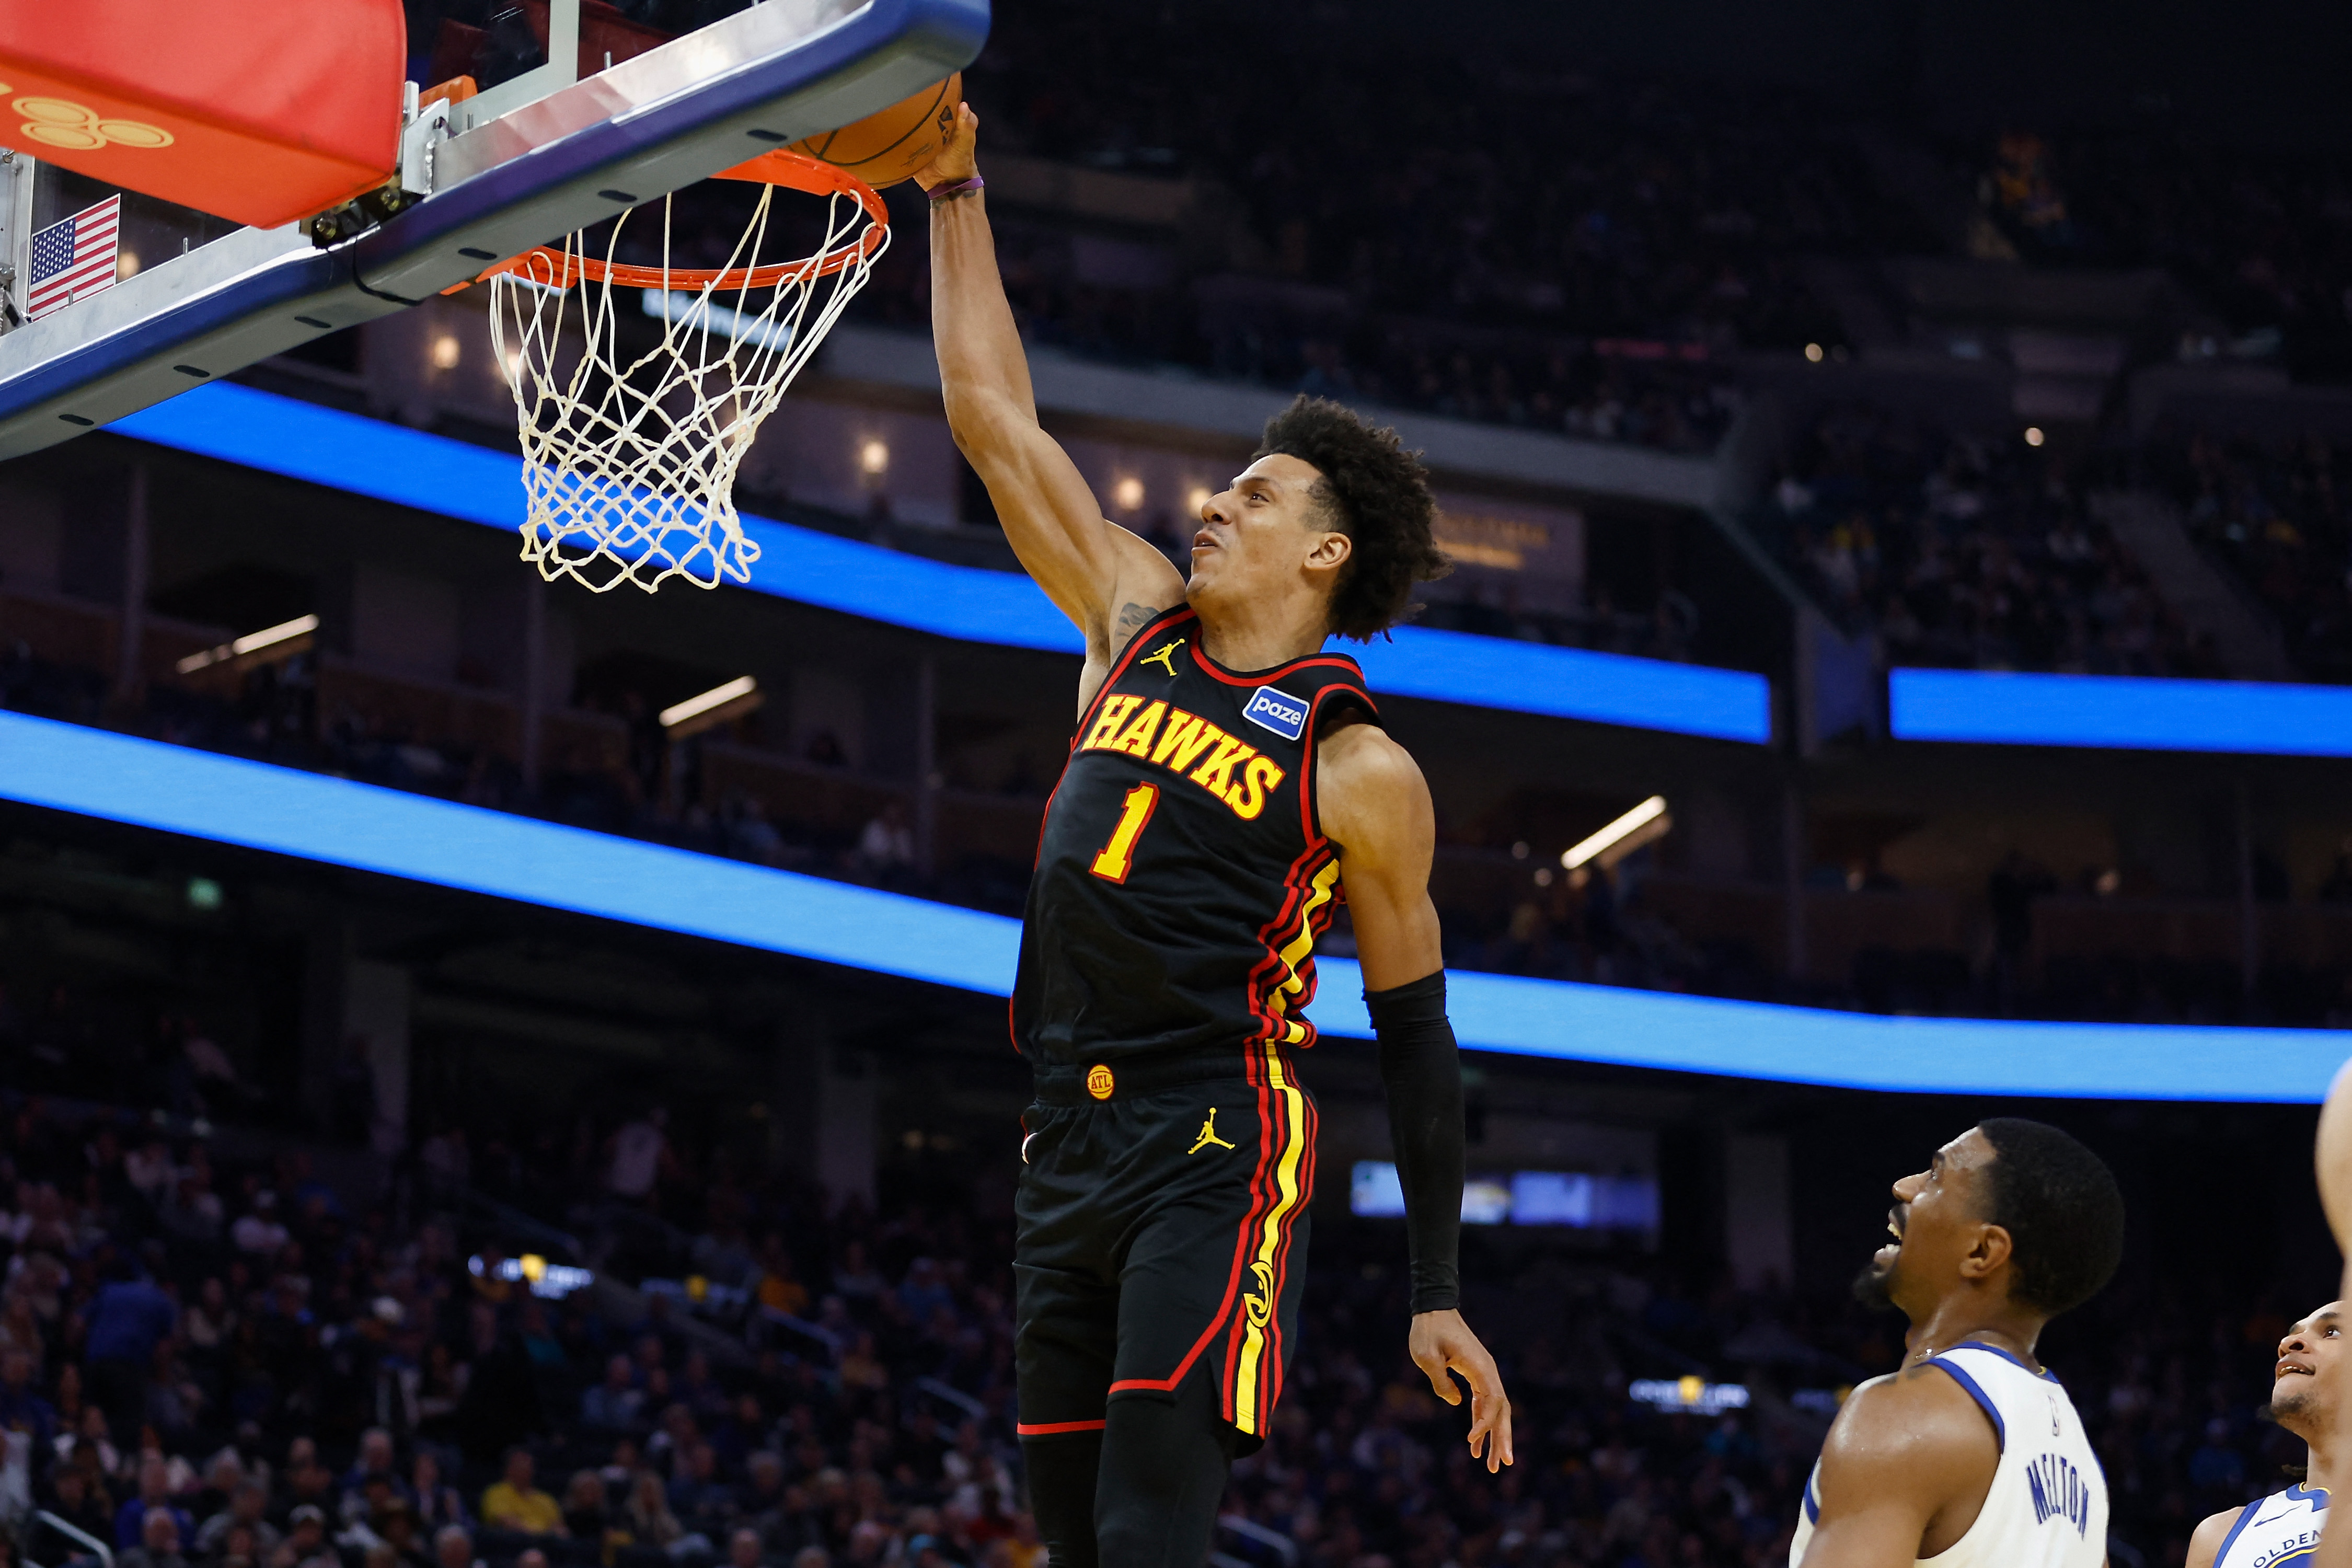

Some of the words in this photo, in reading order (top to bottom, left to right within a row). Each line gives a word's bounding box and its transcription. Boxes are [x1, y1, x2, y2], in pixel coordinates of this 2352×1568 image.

[1252, 696, 1301, 725] paze
[1080, 694, 1286, 822] HAWKS
[1089, 781, 1160, 884] 1
[1091, 1075, 1110, 1089] ATL
[2025, 1453, 2089, 1541] MELTON
